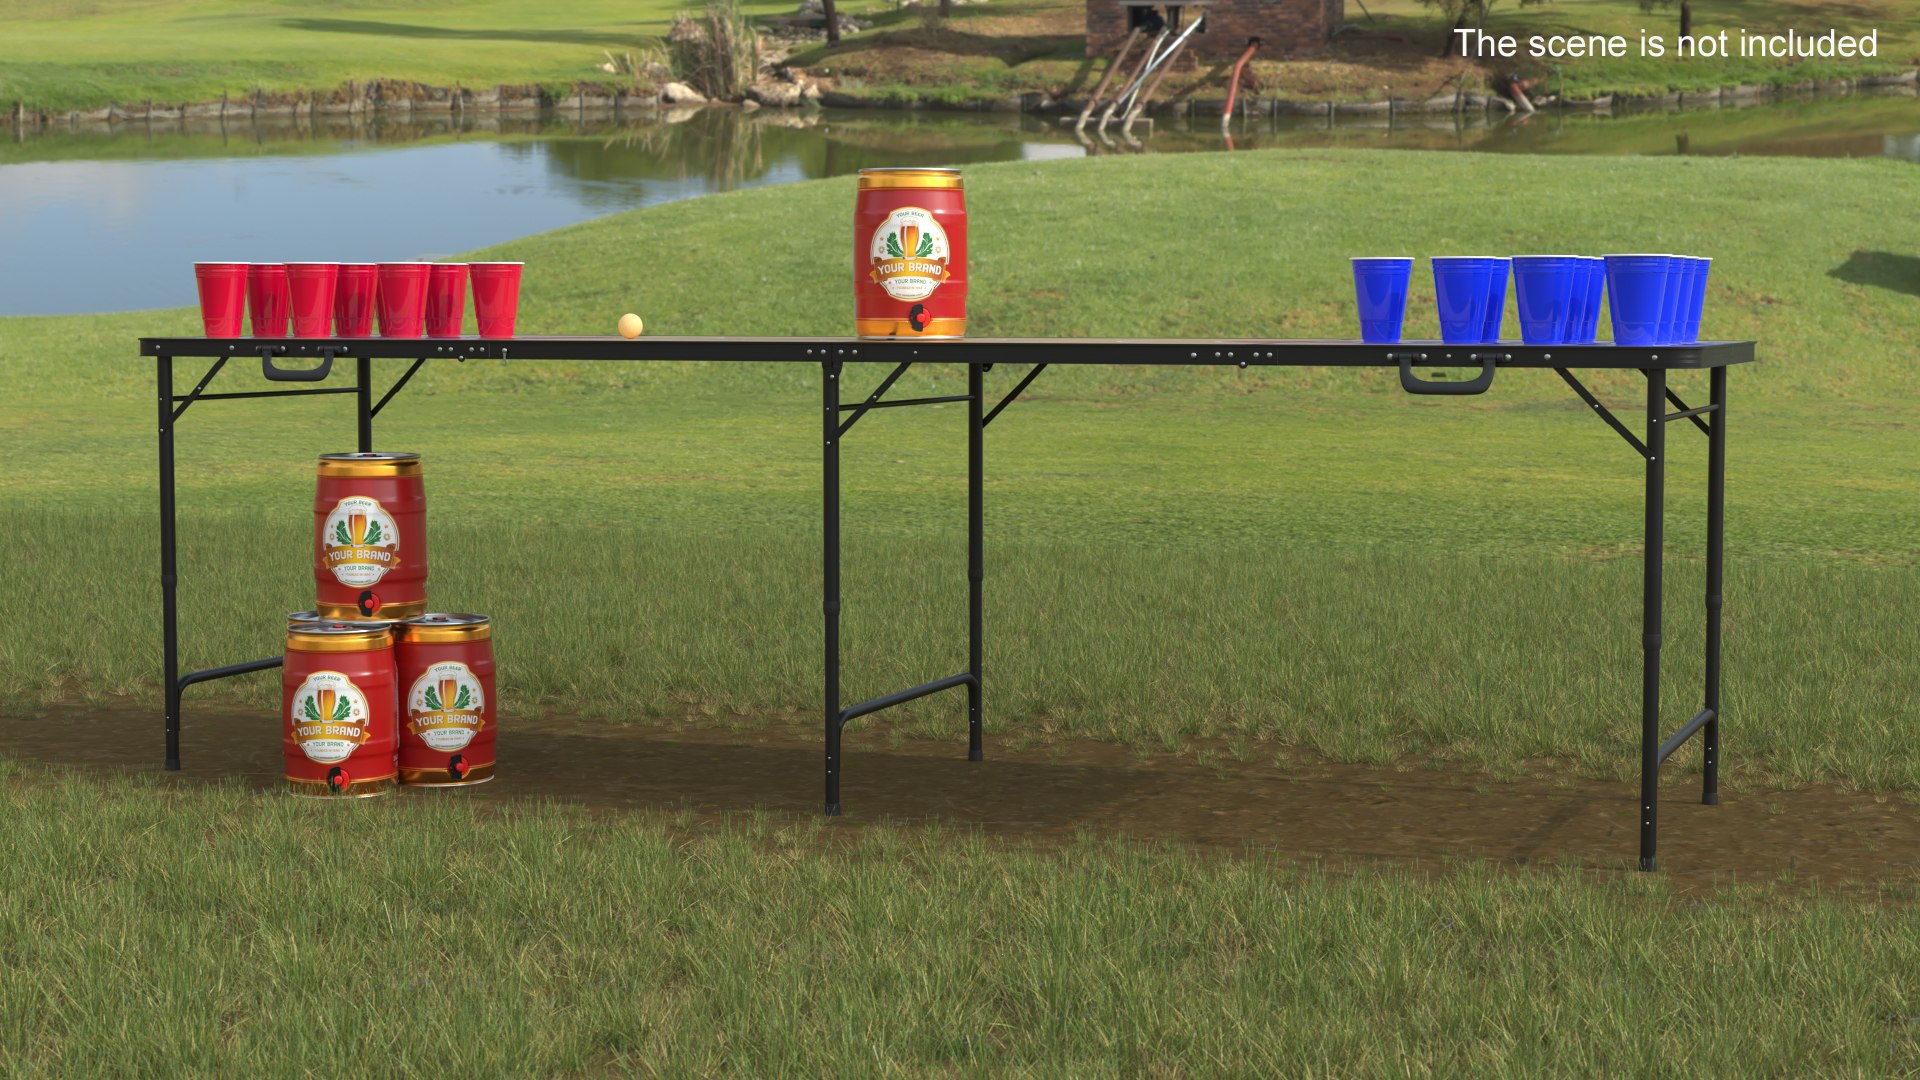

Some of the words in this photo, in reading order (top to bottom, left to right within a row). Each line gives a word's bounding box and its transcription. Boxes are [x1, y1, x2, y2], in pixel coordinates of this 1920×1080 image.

[878, 262, 905, 275] YOUR
[908, 262, 942, 275] BRAND
[328, 550, 353, 562] YOUR
[356, 550, 391, 562] BRAND
[416, 714, 444, 726] YOUR
[448, 714, 478, 725] BRAND
[297, 726, 322, 736] YOUR
[326, 726, 360, 737] BRAND
